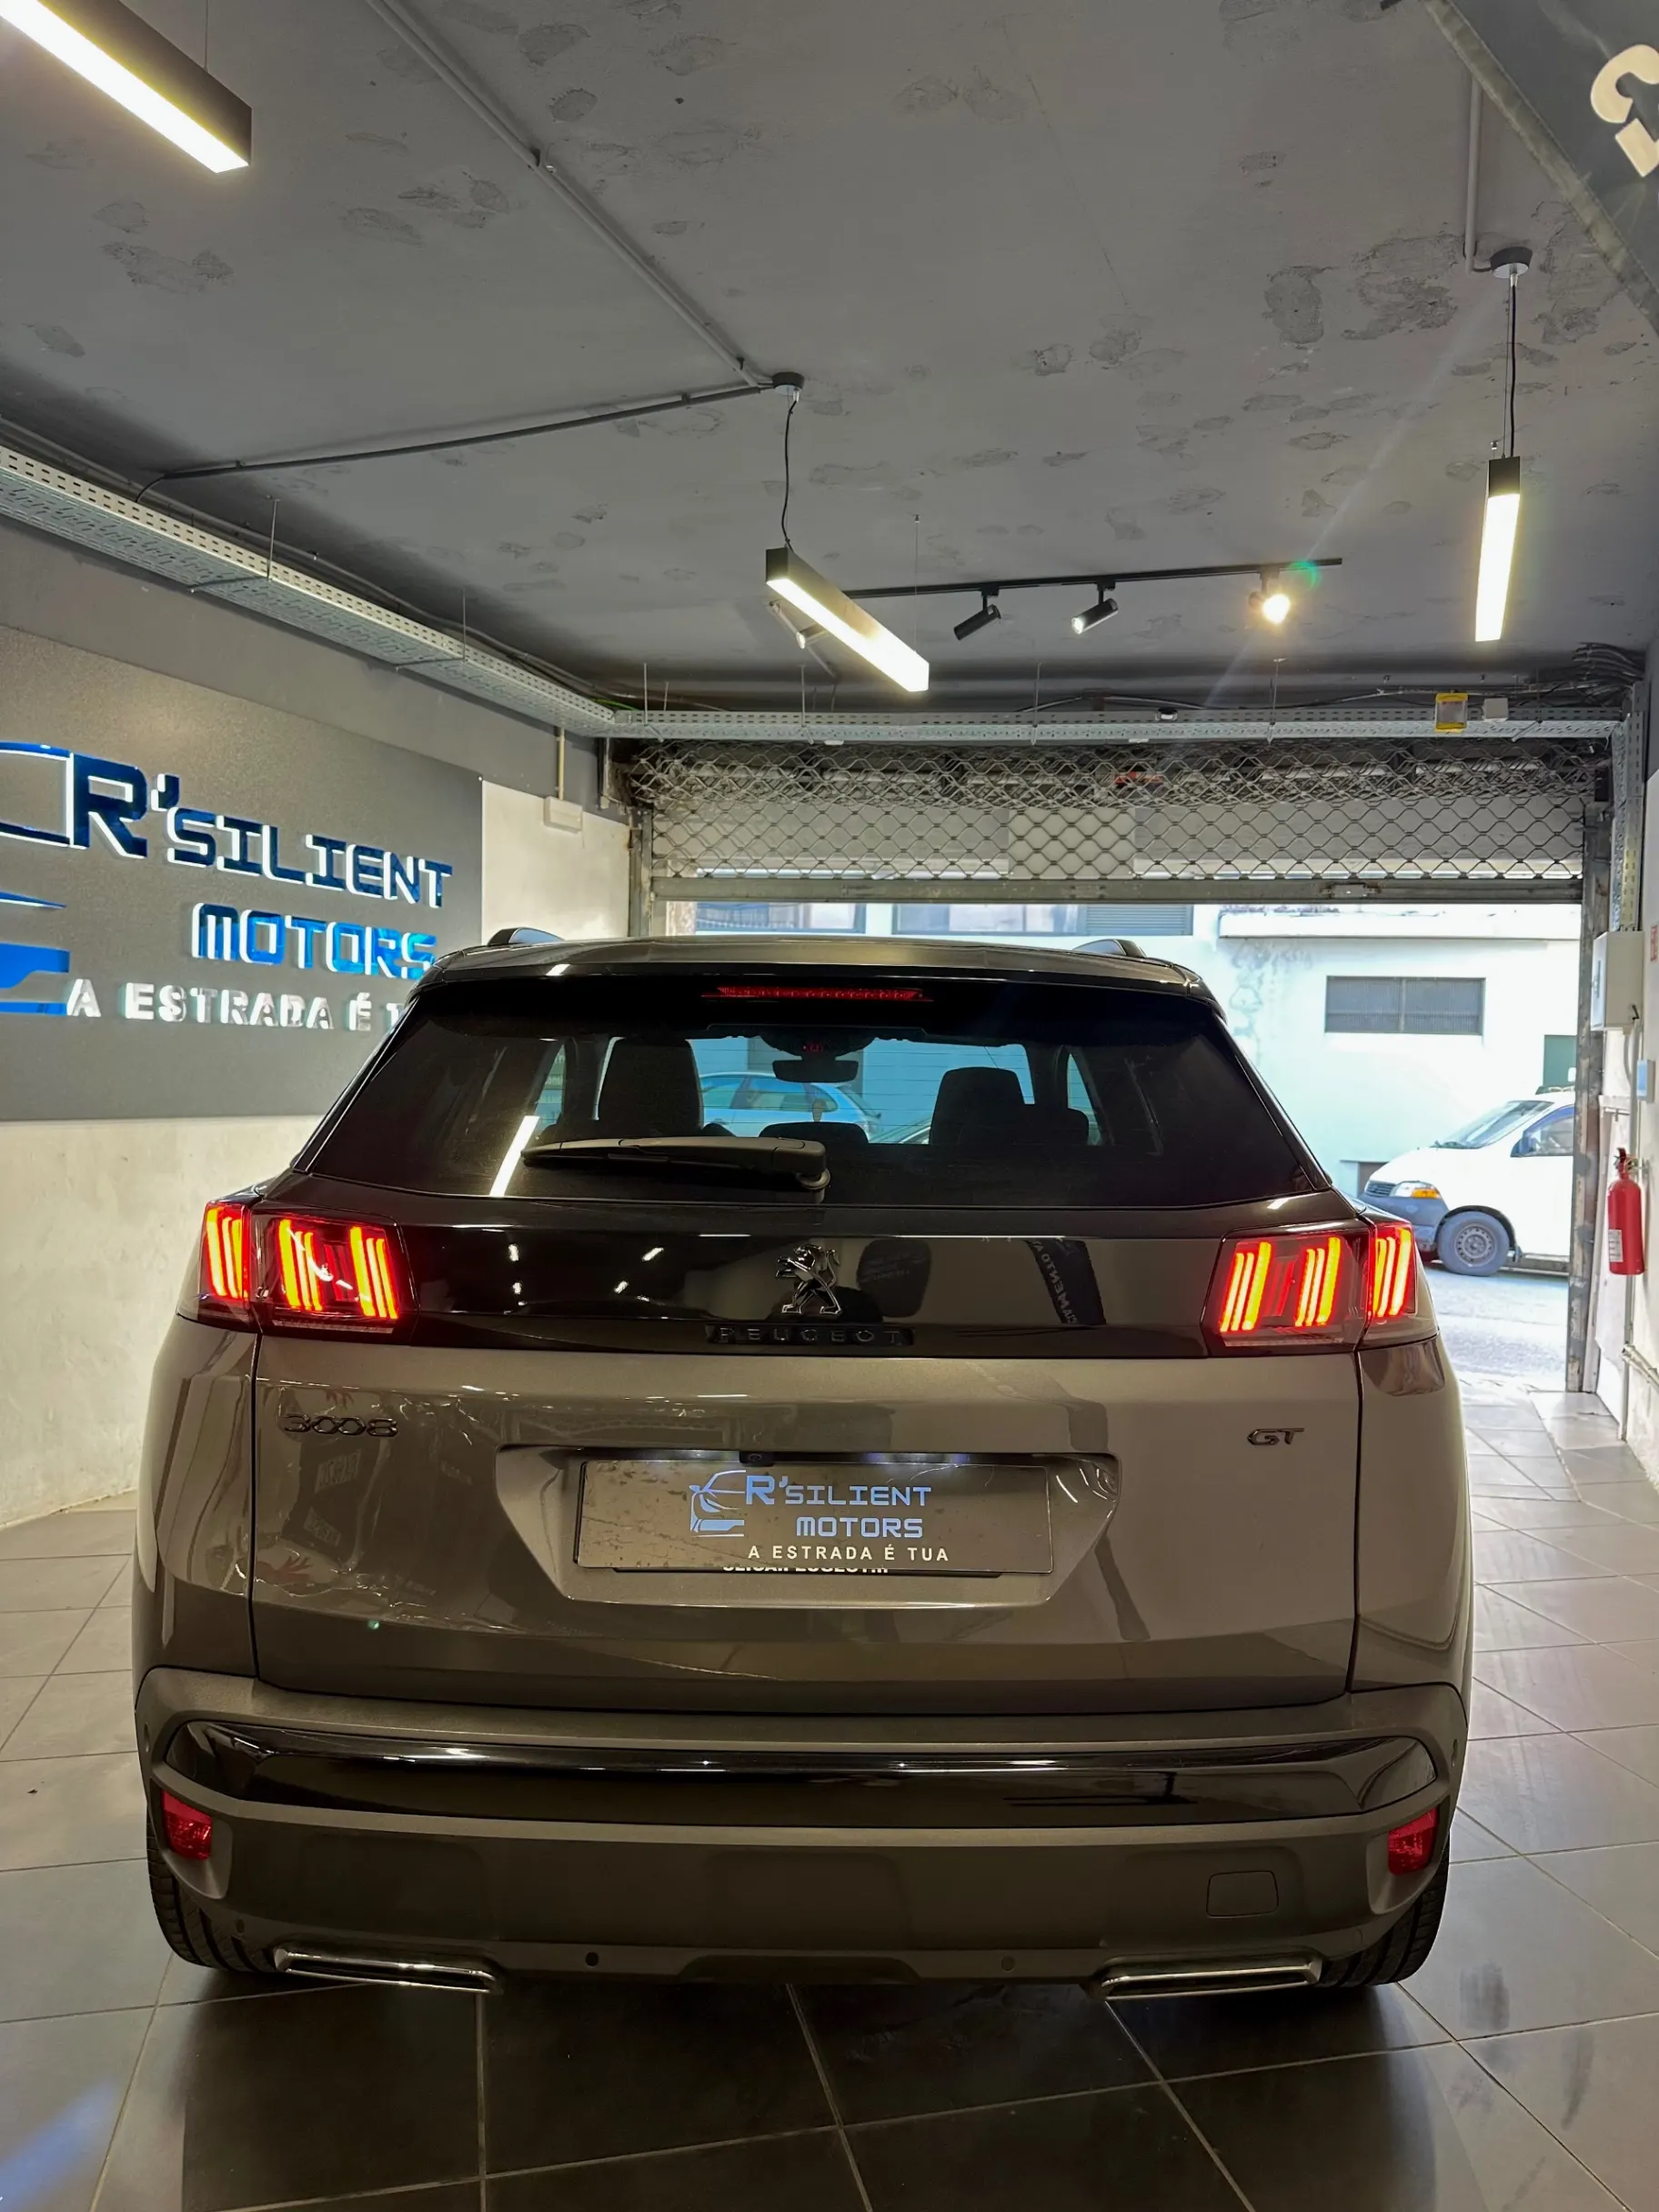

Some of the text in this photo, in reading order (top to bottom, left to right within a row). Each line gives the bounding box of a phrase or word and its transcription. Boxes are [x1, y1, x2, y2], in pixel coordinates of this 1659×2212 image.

[65, 752, 453, 908] R'SILIENT
[191, 902, 437, 980] MOTORS
[65, 979, 102, 1018] A
[125, 982, 335, 1031] ESTRADA
[349, 992, 372, 1031] É
[719, 1326, 903, 1346] PEUGEOT
[284, 1413, 399, 1437] 3008
[1247, 1427, 1305, 1445] GT
[745, 1474, 932, 1506] R'SILIENT
[796, 1516, 924, 1539] MOTORS
[748, 1543, 949, 1562] A ESTRADA É TUA
